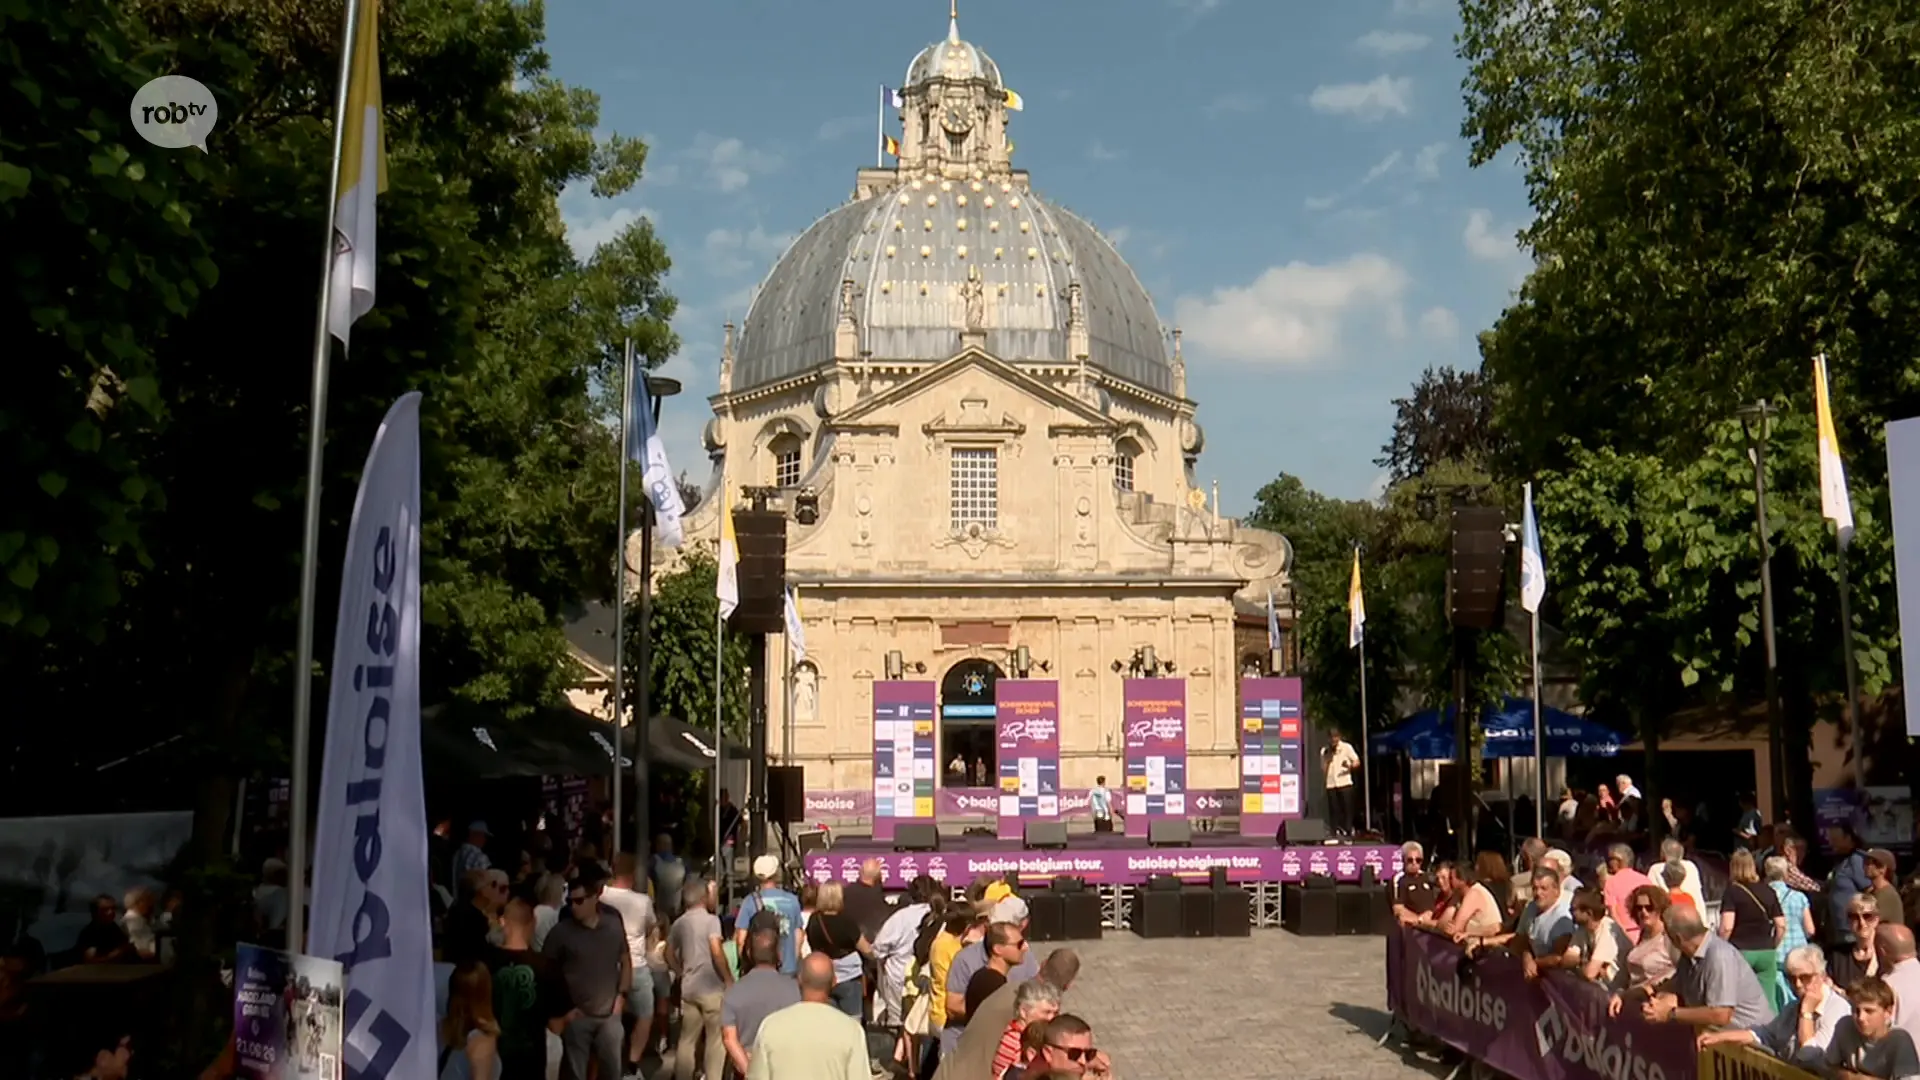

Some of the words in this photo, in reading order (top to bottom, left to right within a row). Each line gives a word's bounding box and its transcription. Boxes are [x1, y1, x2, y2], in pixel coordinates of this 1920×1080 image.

[806, 797, 854, 811] baloise
[968, 858, 1017, 872] baloise
[1019, 858, 1073, 874] belgium
[1074, 859, 1104, 871] tour.
[1128, 857, 1177, 870] baloise
[1178, 856, 1231, 871] belgium
[1231, 856, 1261, 869] tour.
[1428, 963, 1507, 1031] baloise
